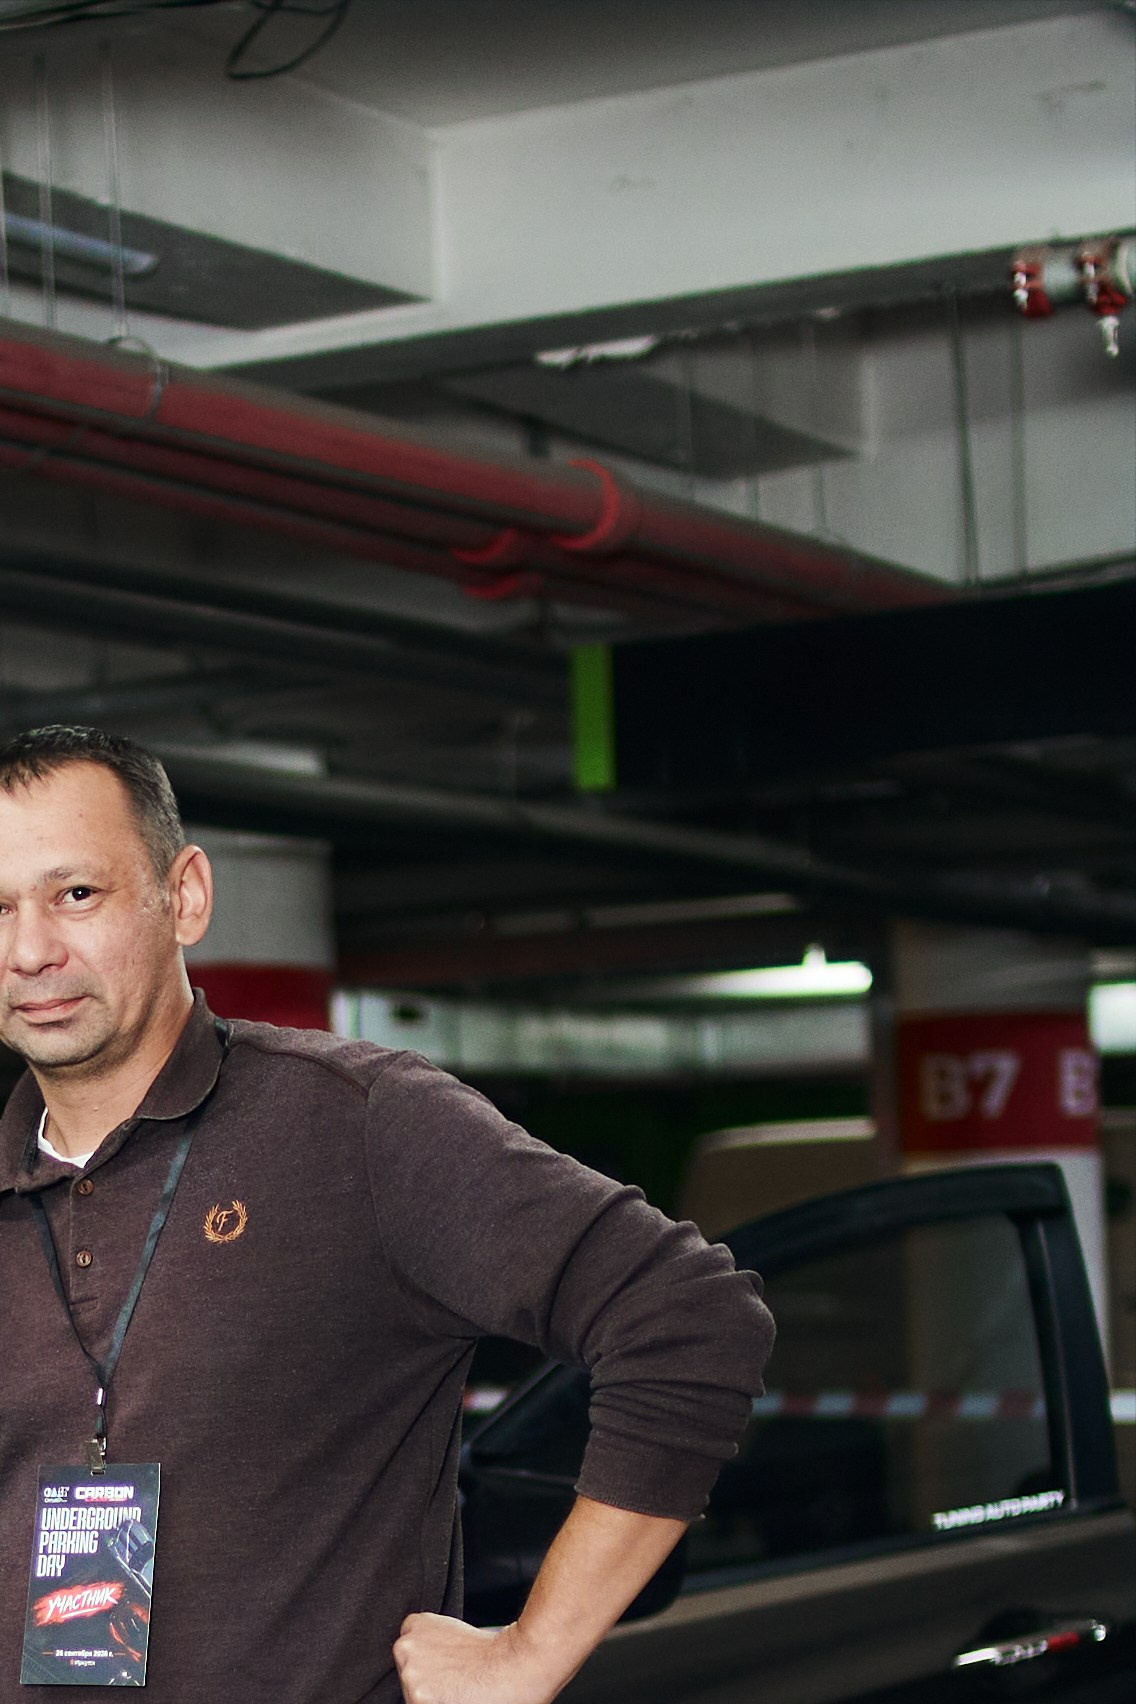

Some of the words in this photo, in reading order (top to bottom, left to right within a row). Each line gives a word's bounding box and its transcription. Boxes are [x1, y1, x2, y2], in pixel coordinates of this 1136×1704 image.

[75, 1486, 134, 1500] CARBON
[41, 1507, 142, 1531] UNDERGROUND
[39, 1531, 99, 1554] PARKING
[36, 1554, 66, 1577] DAY
[45, 1587, 118, 1620] УЧАСТНИК
